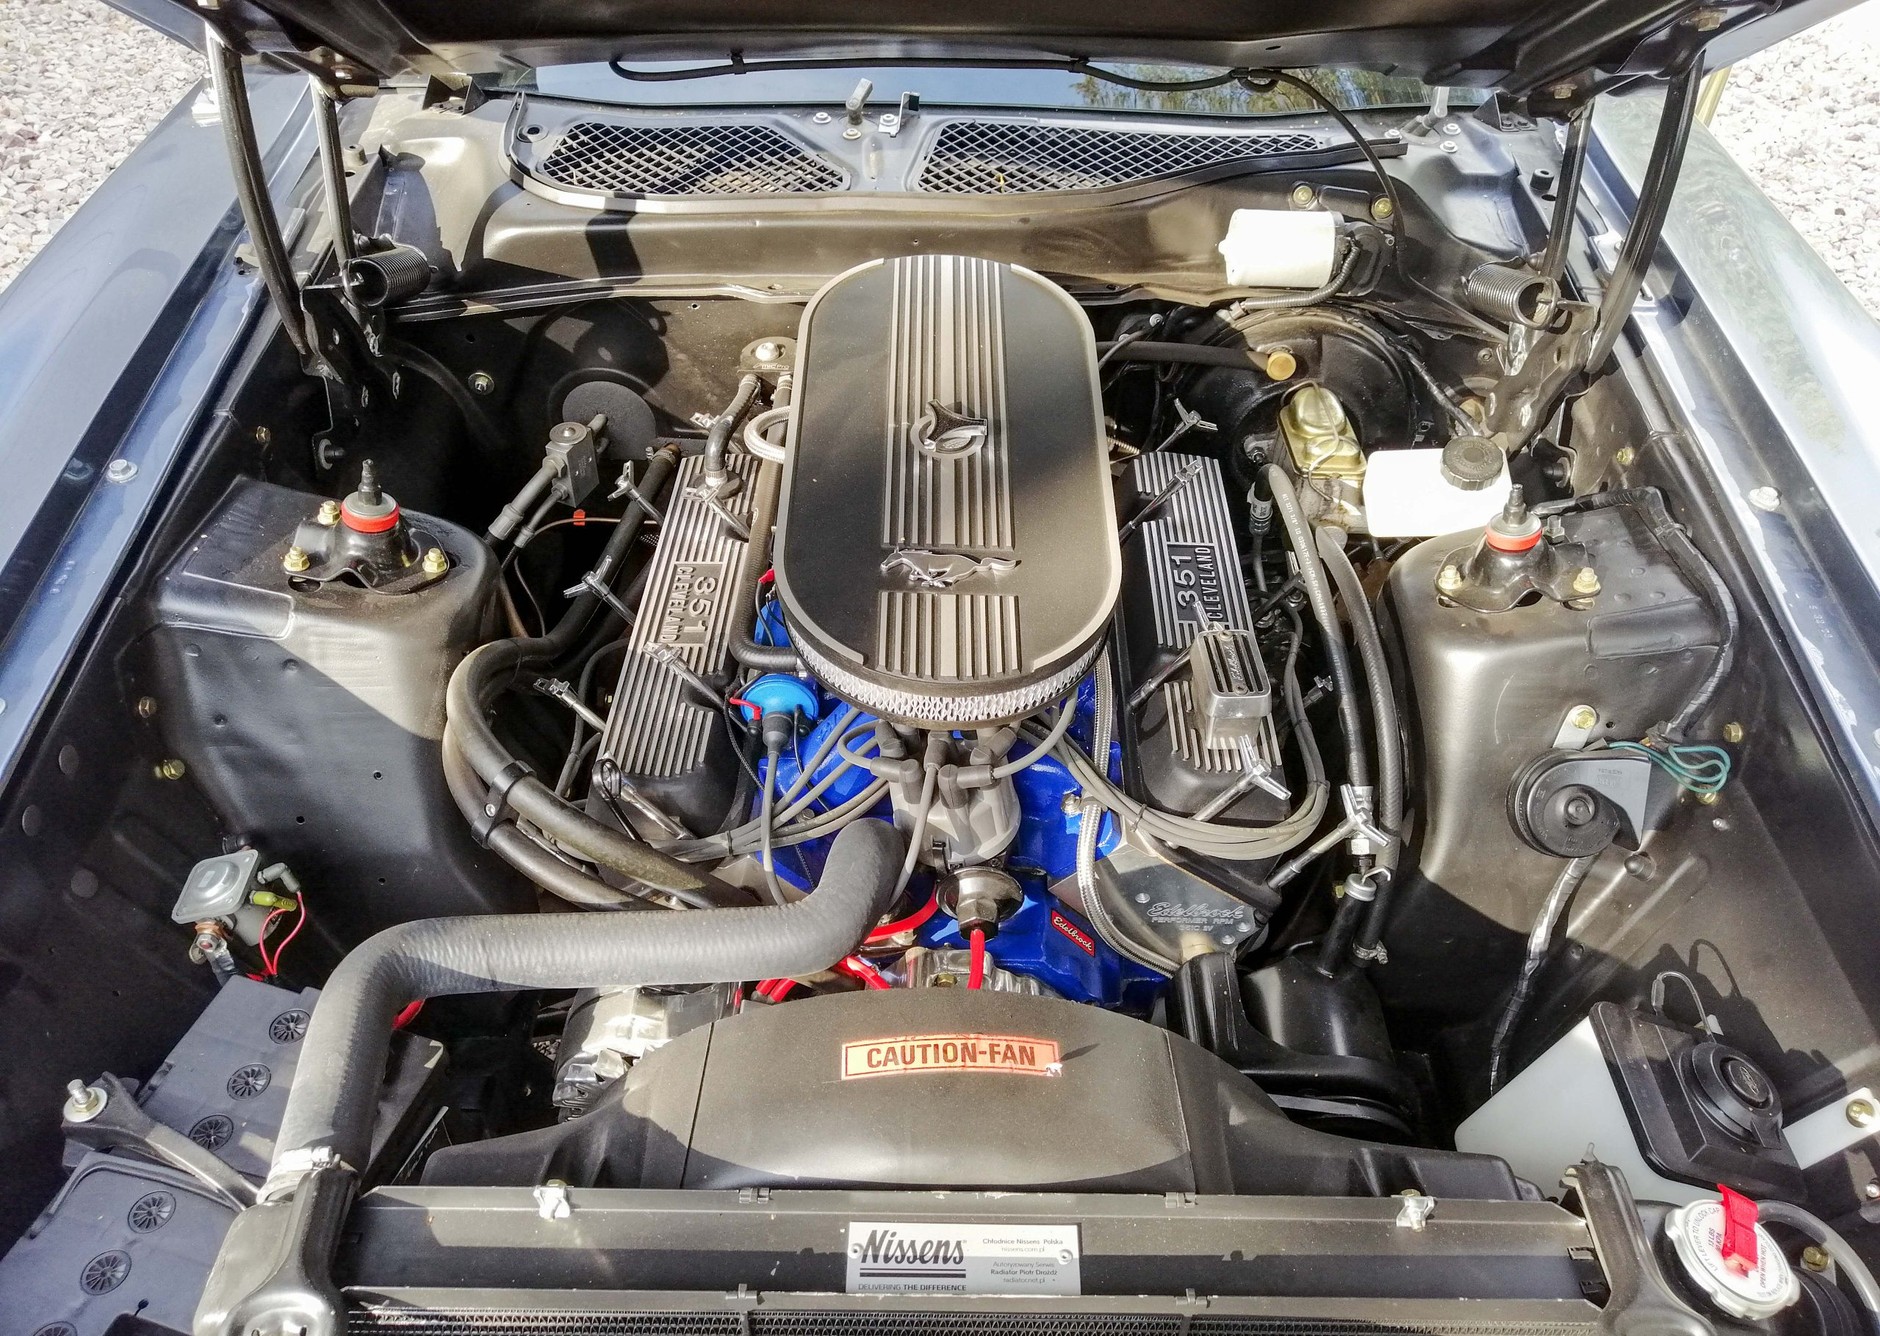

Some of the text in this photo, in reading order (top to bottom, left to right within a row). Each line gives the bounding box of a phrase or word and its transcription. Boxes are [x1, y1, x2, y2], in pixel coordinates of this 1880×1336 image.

[1171, 555, 1199, 606] 351
[1195, 547, 1224, 619] CLEVELAND
[661, 566, 696, 641] CLEVELAND
[684, 577, 716, 633] 351
[1147, 902, 1245, 919] Edelbrock
[1053, 916, 1092, 951] Edelbrock
[867, 1042, 1036, 1069] CAUTION-FAN
[861, 1230, 964, 1265] Nissens
